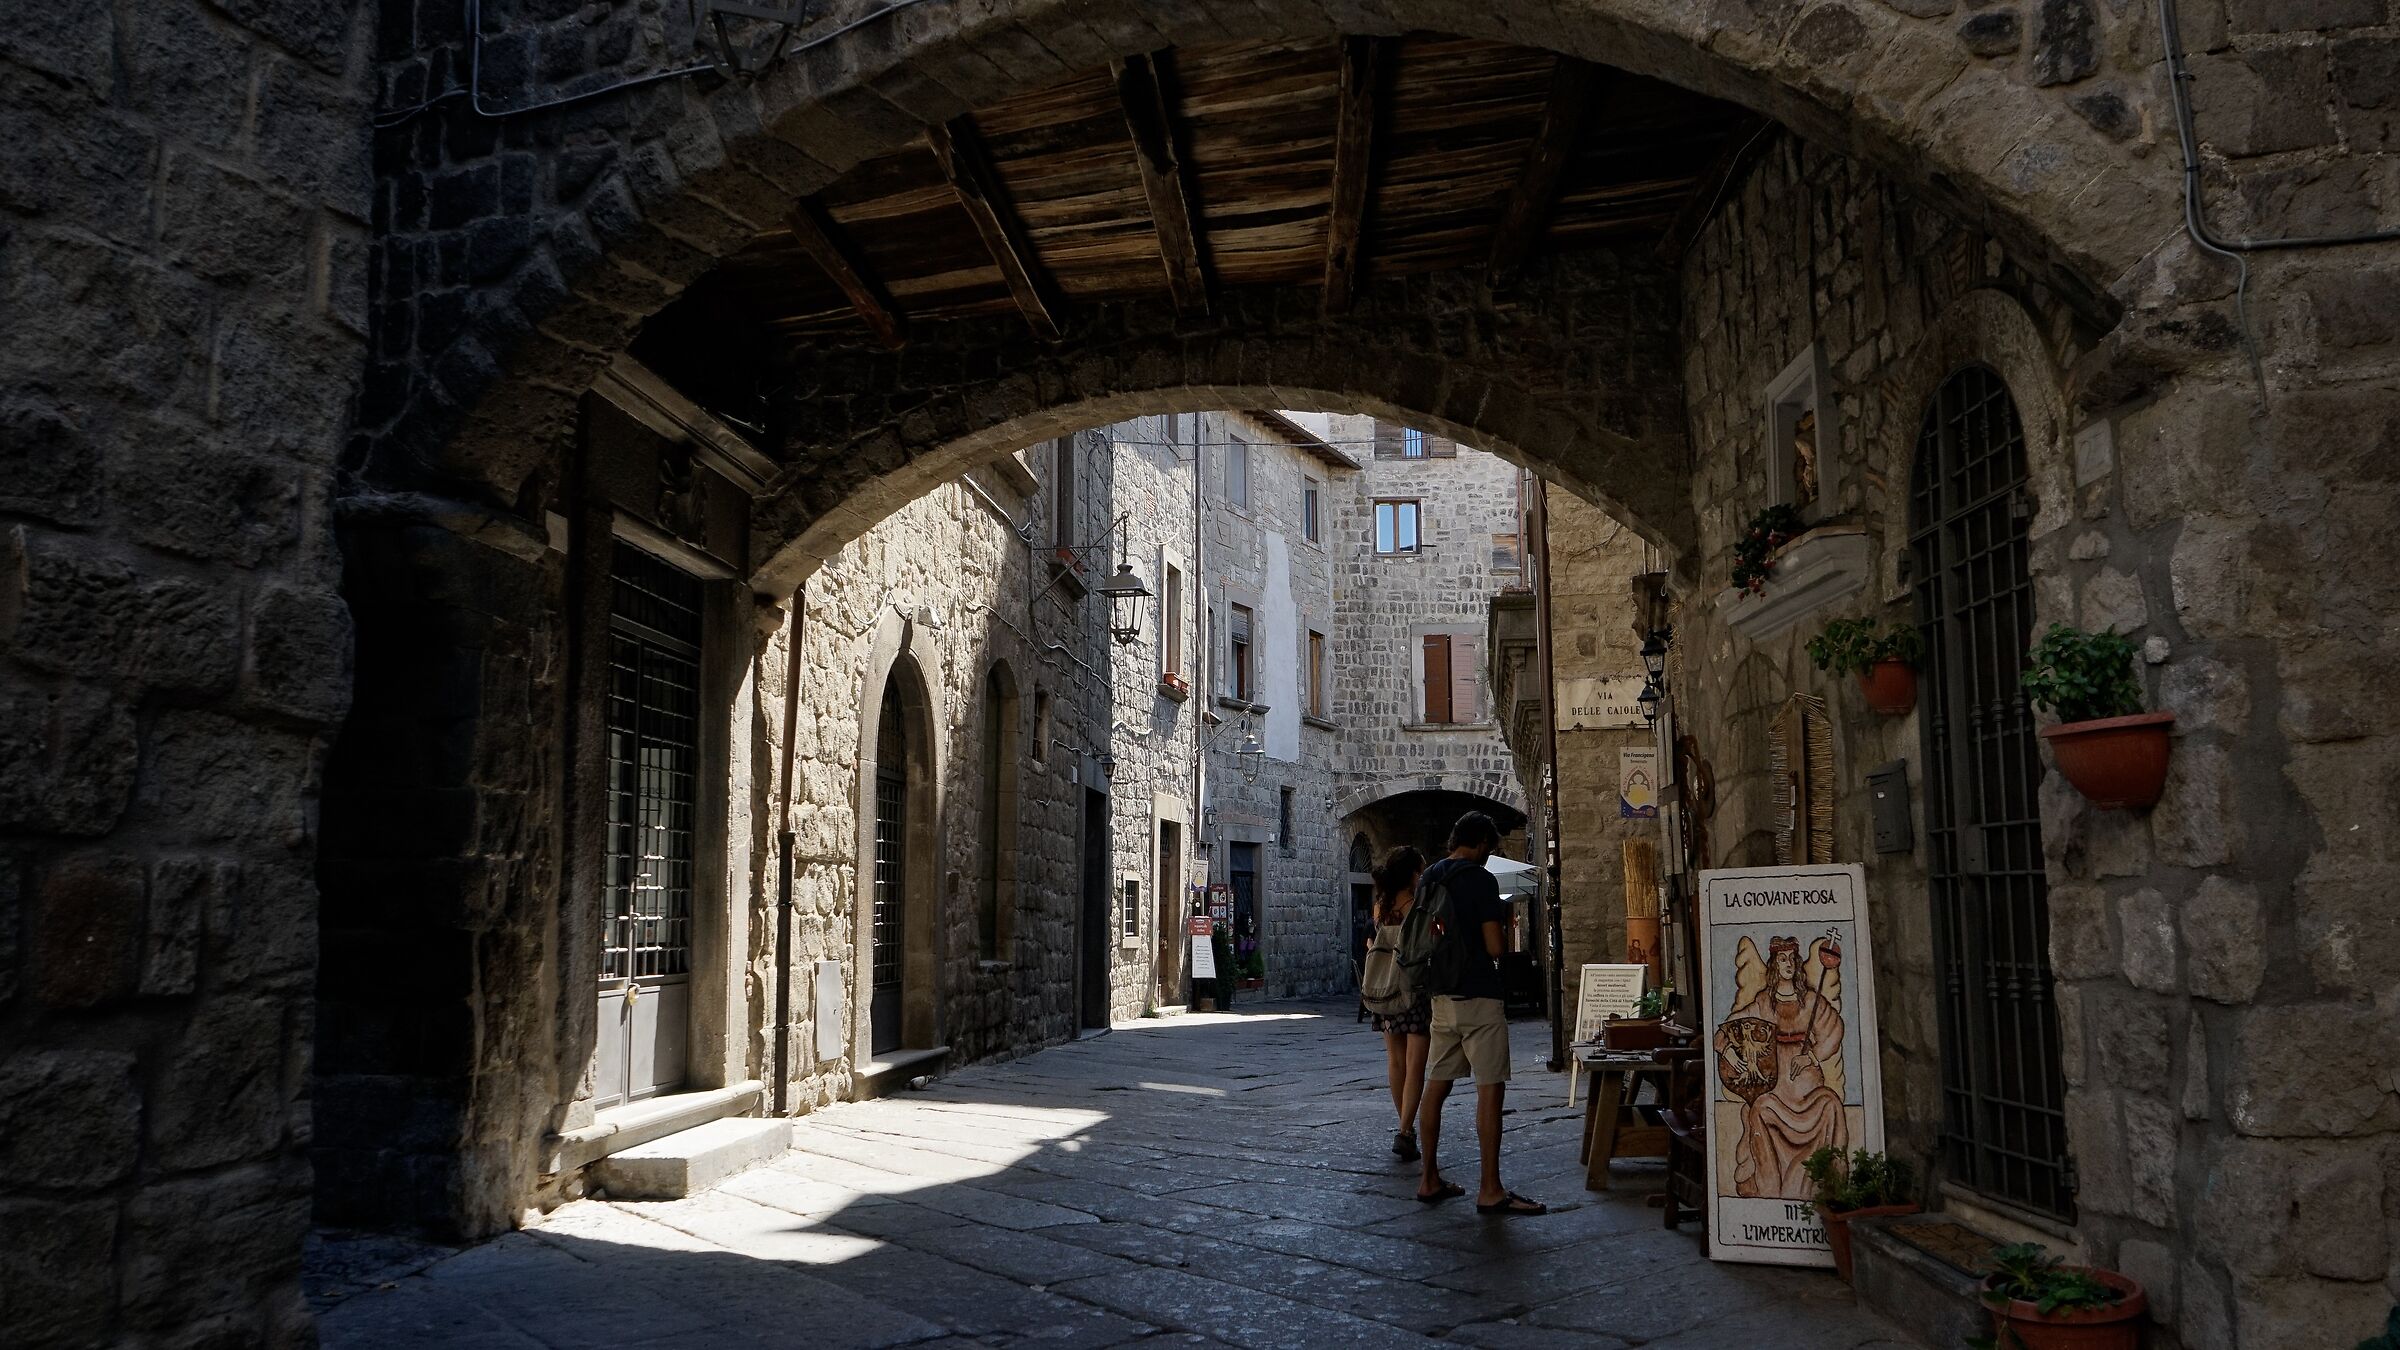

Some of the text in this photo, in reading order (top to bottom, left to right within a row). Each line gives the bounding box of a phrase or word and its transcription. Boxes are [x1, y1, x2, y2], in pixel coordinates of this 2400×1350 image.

[1597, 691, 1613, 700] VIA
[1571, 705, 1641, 716] DELLE CAIOLE
[1724, 889, 1838, 907] LA GIOVANE ROSA
